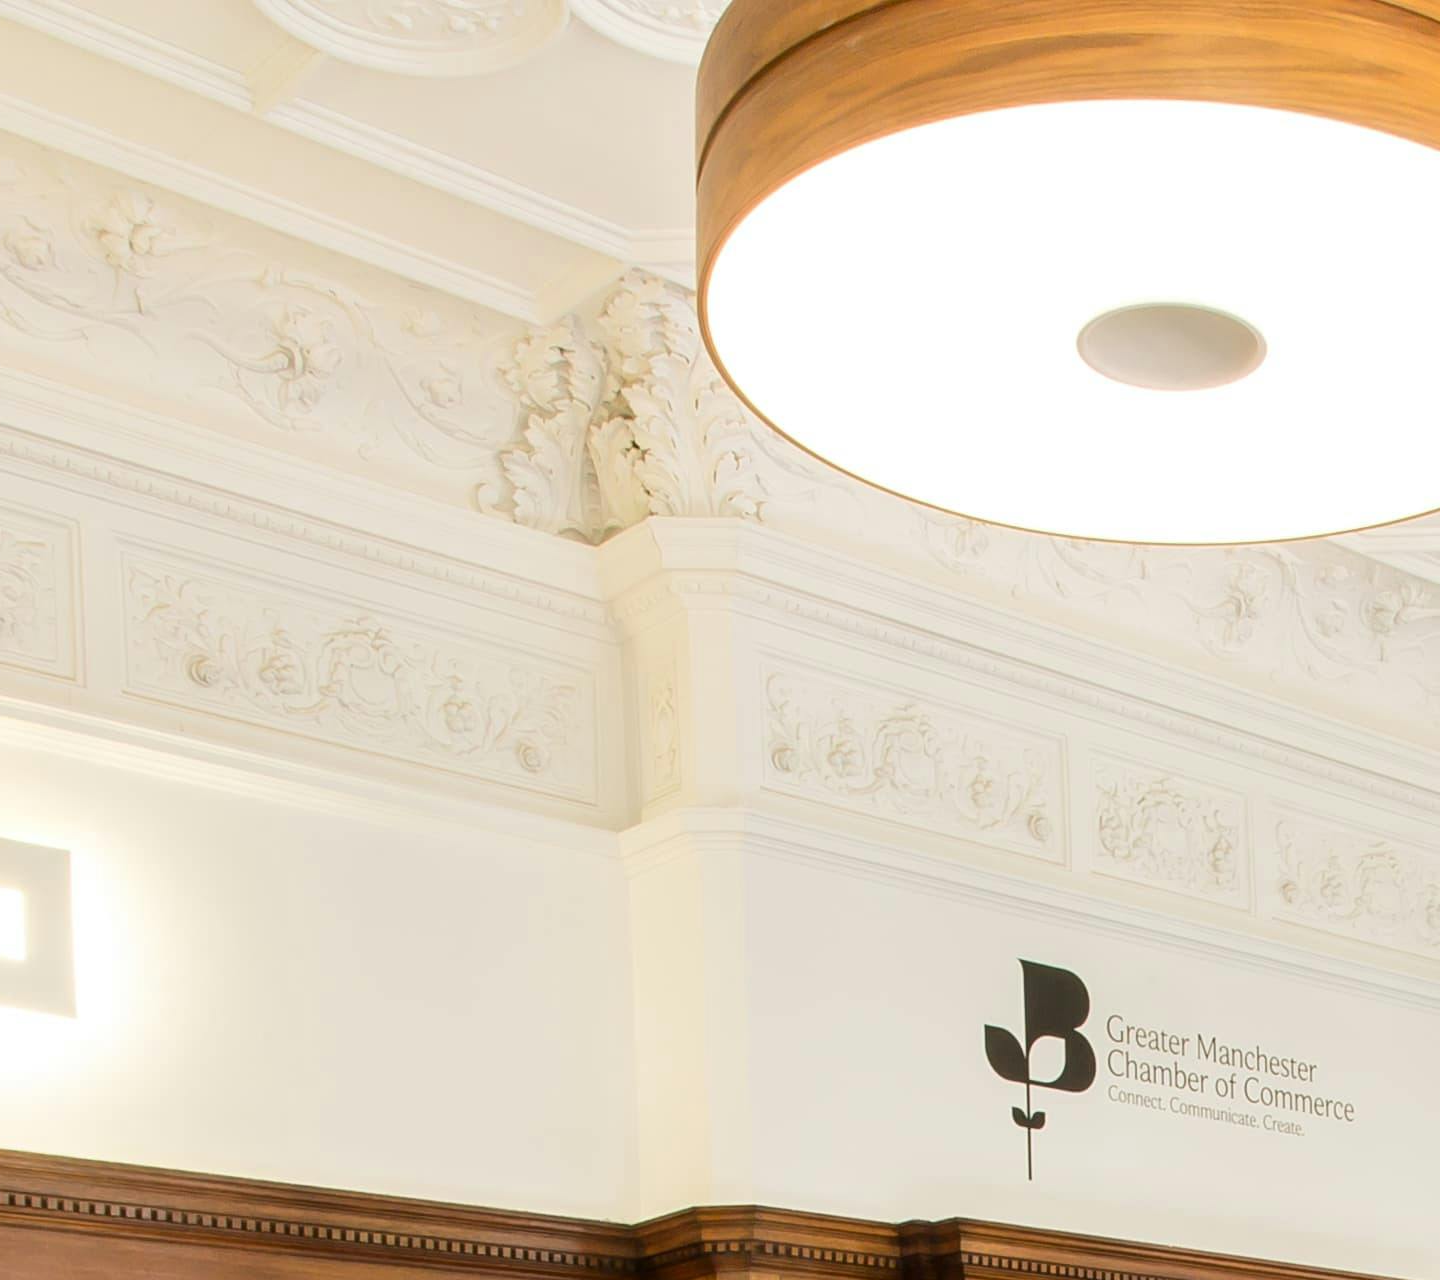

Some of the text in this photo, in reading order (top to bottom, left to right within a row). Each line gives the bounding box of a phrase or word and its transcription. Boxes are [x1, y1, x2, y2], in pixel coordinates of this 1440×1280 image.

[1106, 1014, 1318, 1082] Greater Manchester
[1107, 1048, 1355, 1122] Chamber of Commerce
[1108, 1084, 1305, 1137] Connect. Communicate. Create.
